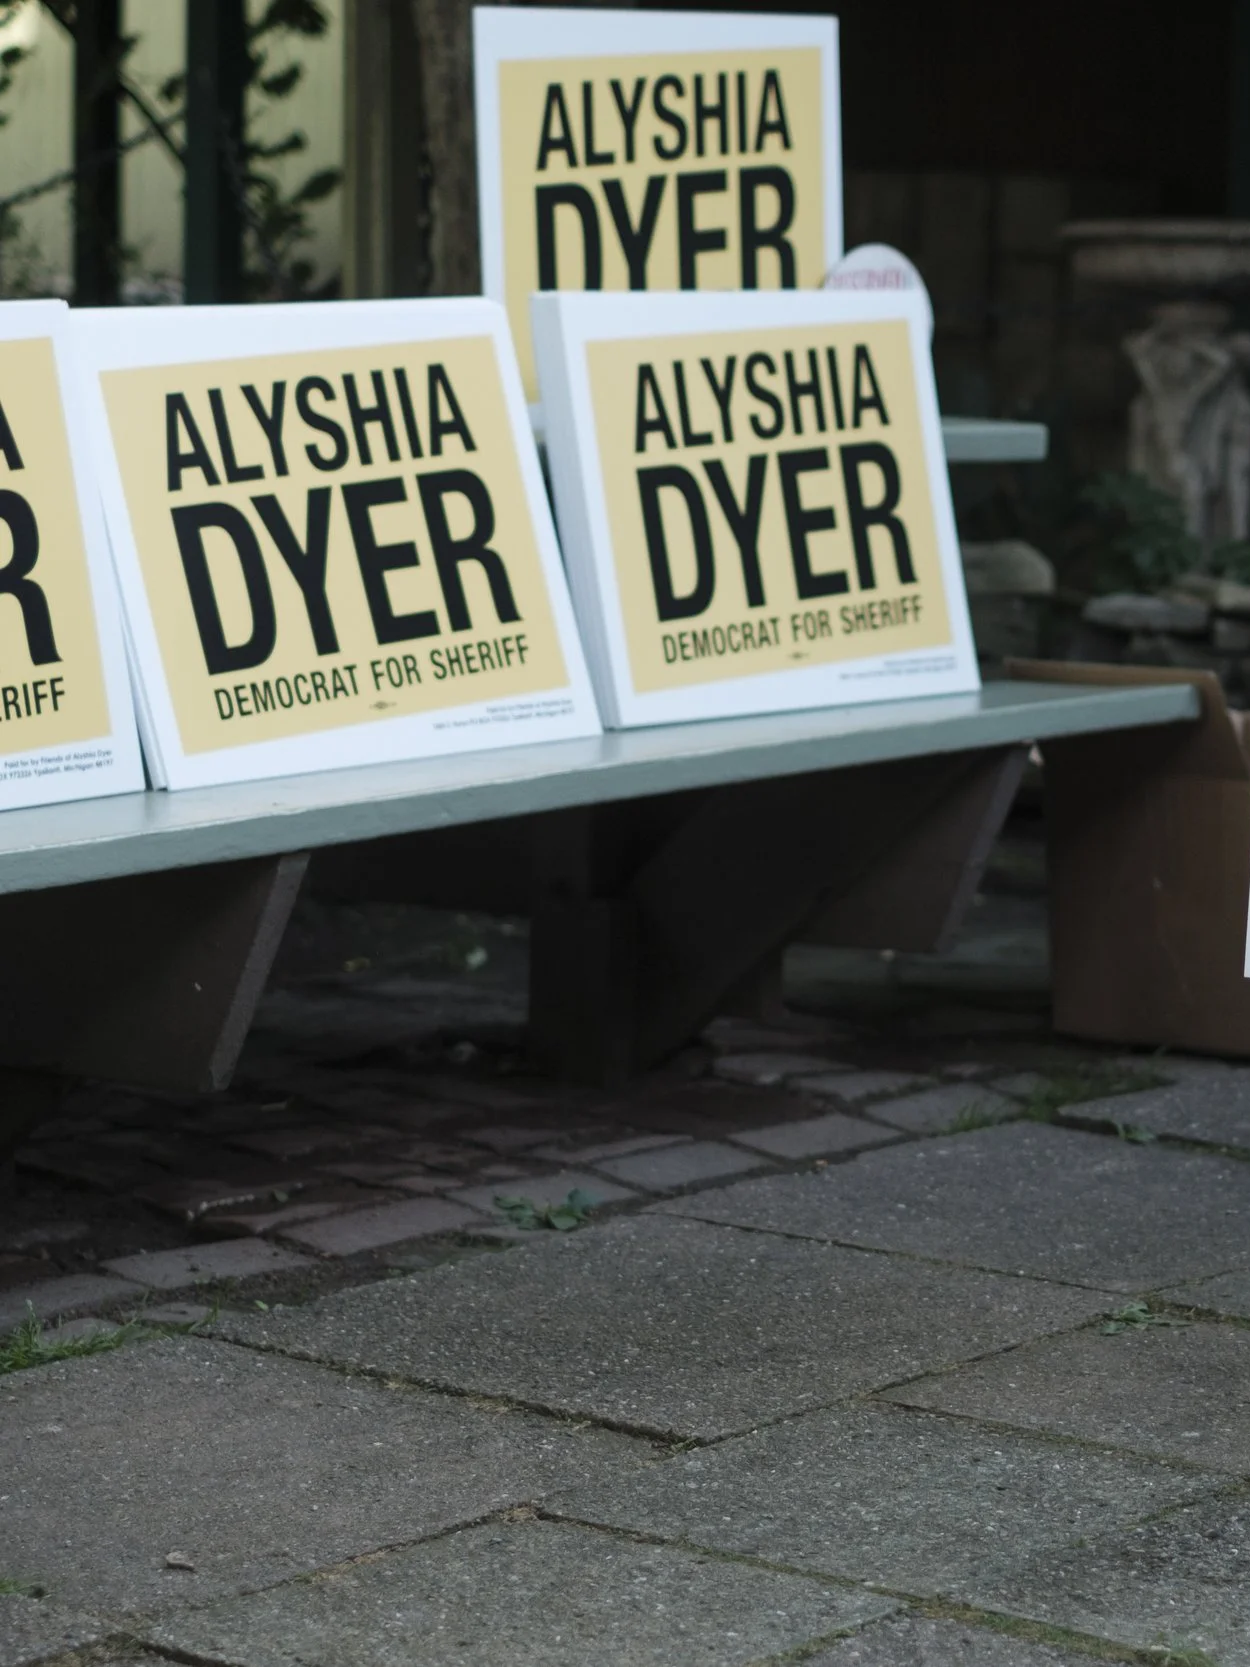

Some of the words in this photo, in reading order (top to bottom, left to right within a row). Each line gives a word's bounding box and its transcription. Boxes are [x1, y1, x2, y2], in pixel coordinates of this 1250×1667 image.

[536, 69, 792, 171] ALYSHIA
[165, 363, 477, 492] ALYSHIA
[635, 344, 890, 453] ALYSHIA
[170, 468, 524, 676] DYER
[636, 441, 918, 623] DYER
[214, 665, 360, 721] DEMOCRAT
[371, 655, 422, 690] FOR
[431, 635, 529, 680] SHERIFF
[662, 617, 782, 664] DEMOCRAT
[791, 611, 833, 640] FOR
[841, 596, 923, 634] SHERIFF
[0, 677, 65, 722] RIFF
